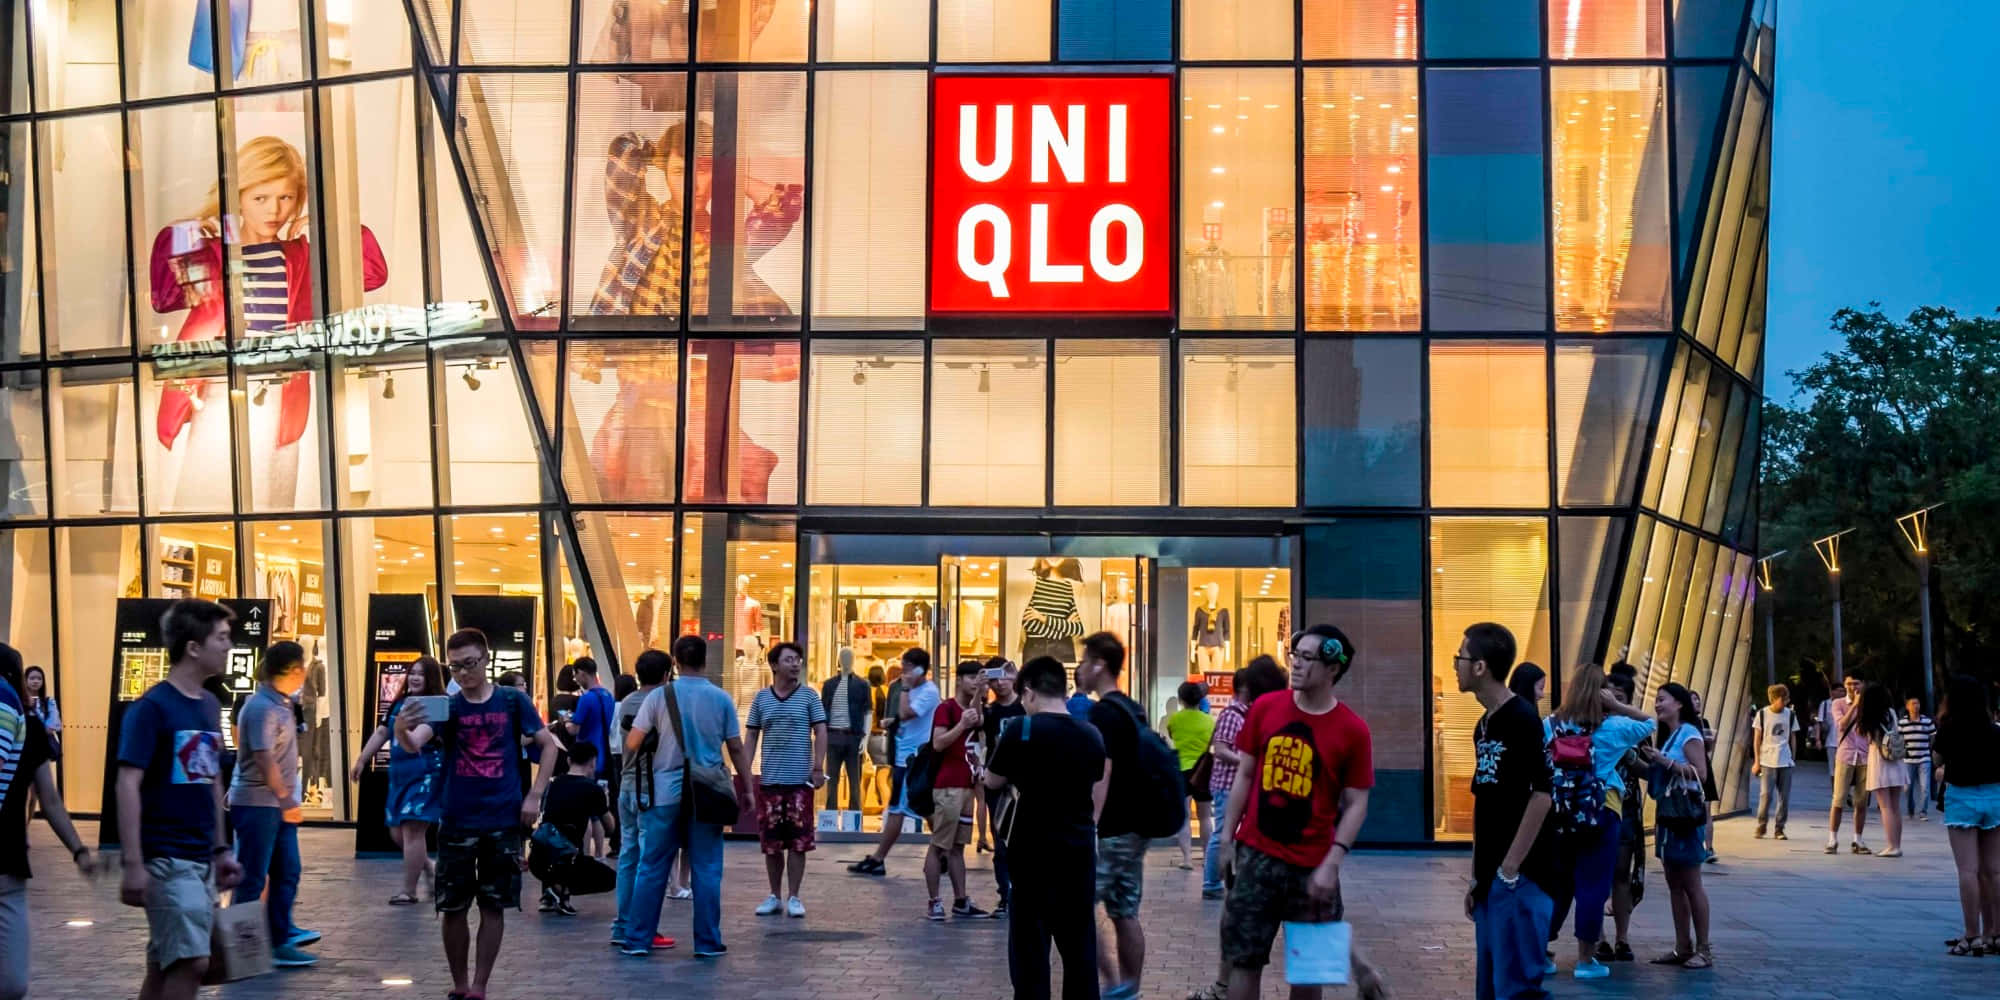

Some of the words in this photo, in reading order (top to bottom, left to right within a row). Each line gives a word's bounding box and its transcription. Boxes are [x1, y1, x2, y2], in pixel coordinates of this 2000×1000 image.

[959, 104, 1127, 183] UNI
[957, 203, 1144, 298] QLO
[206, 559, 222, 576] NEW
[200, 578, 228, 597] ARRIVAL
[306, 573, 319, 589] NEW
[1206, 674, 1221, 687] UT
